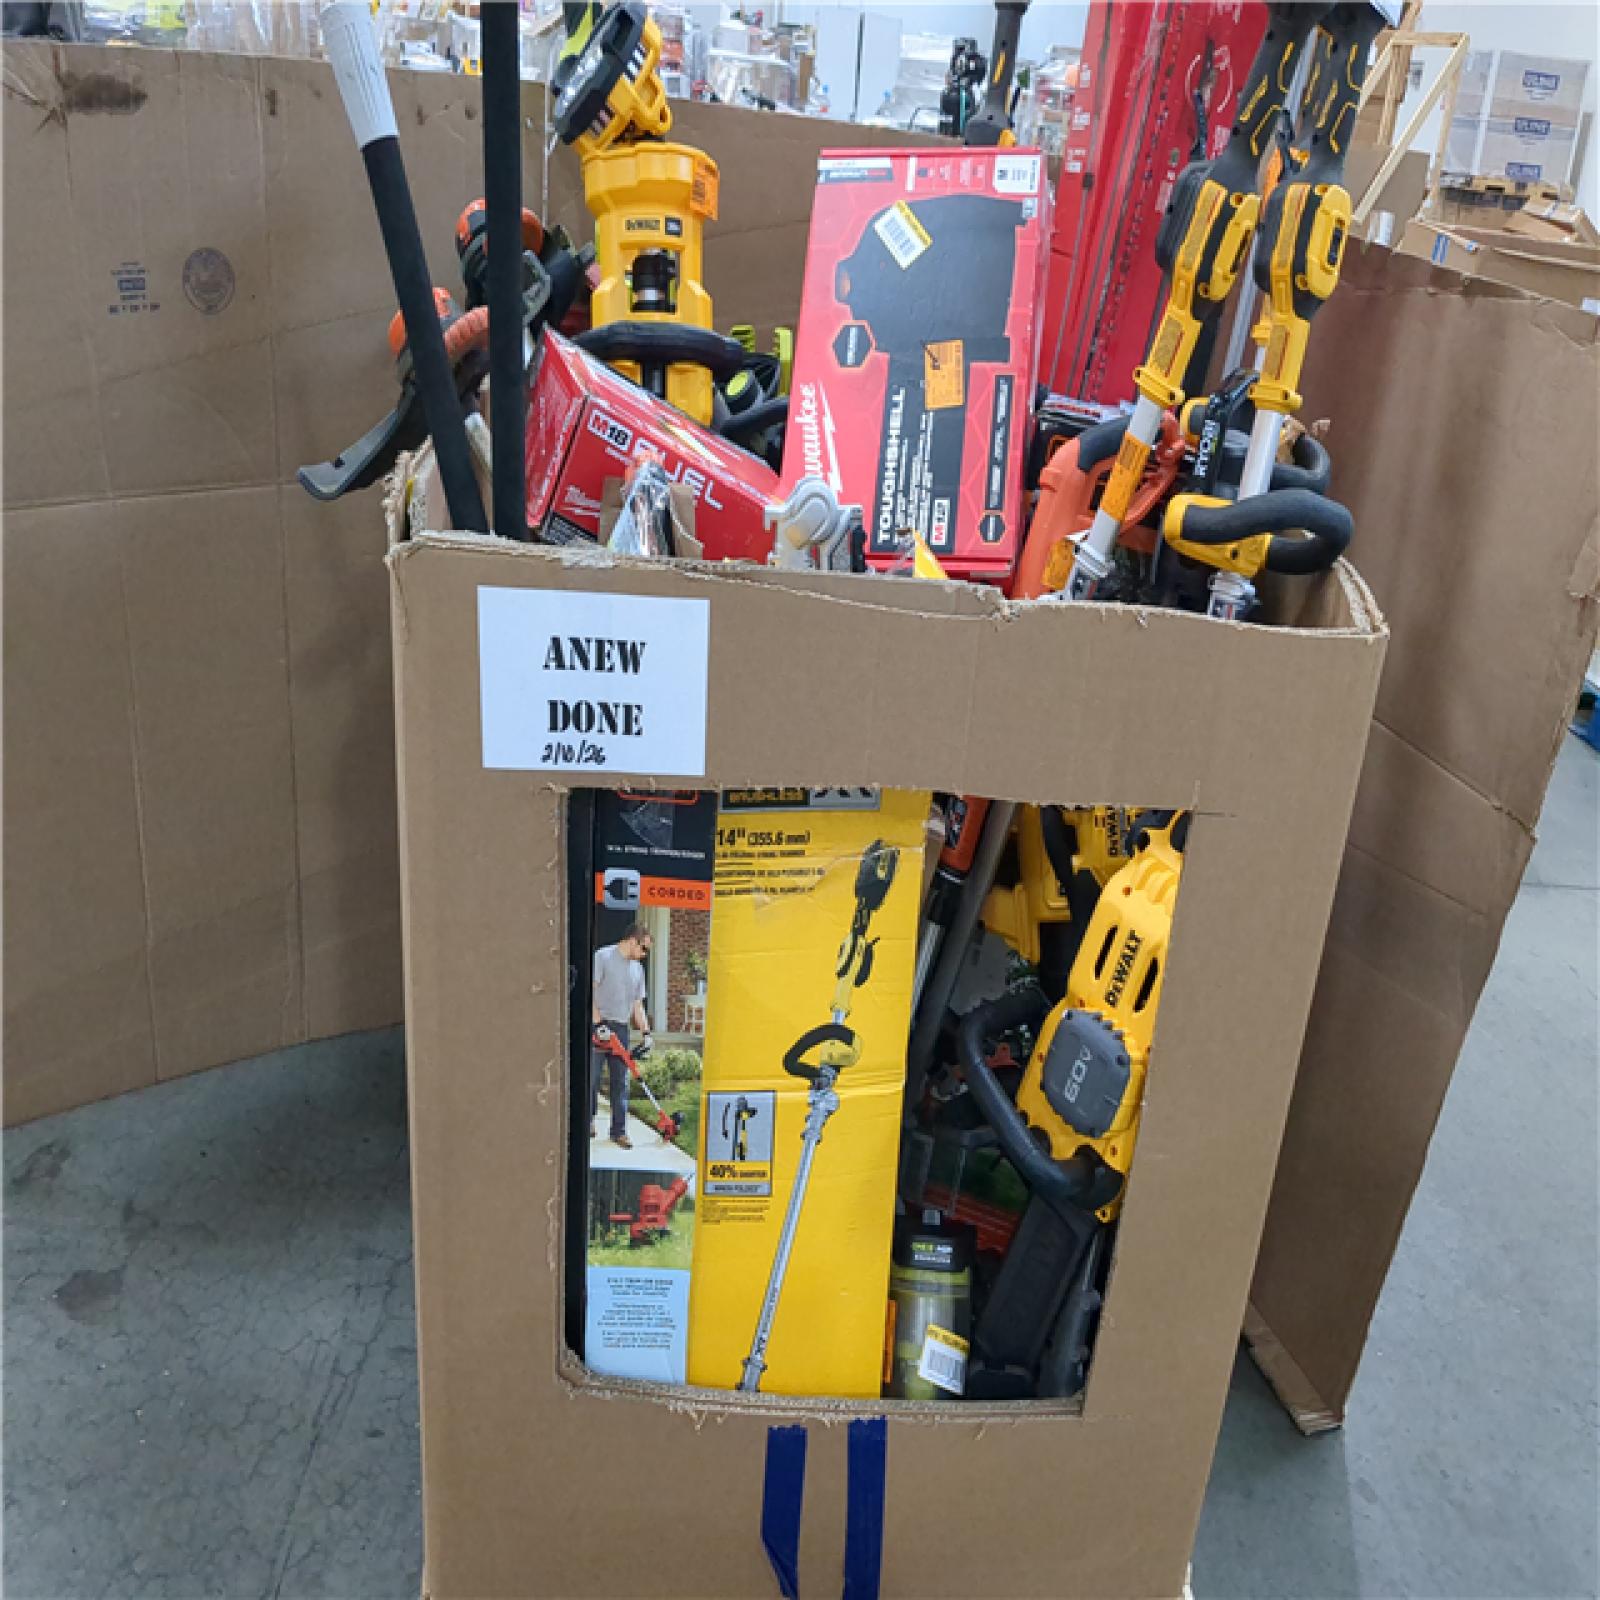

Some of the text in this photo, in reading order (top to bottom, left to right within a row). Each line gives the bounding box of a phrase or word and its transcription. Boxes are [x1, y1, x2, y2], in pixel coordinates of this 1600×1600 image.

[589, 410, 631, 450] M18
[877, 386, 906, 545] TOUGHSHELL
[542, 636, 648, 675] ANEW
[547, 699, 643, 736] DONE
[648, 887, 706, 901] CORDED
[1105, 930, 1143, 1008] DEWALT
[1064, 1046, 1092, 1104] 60V
